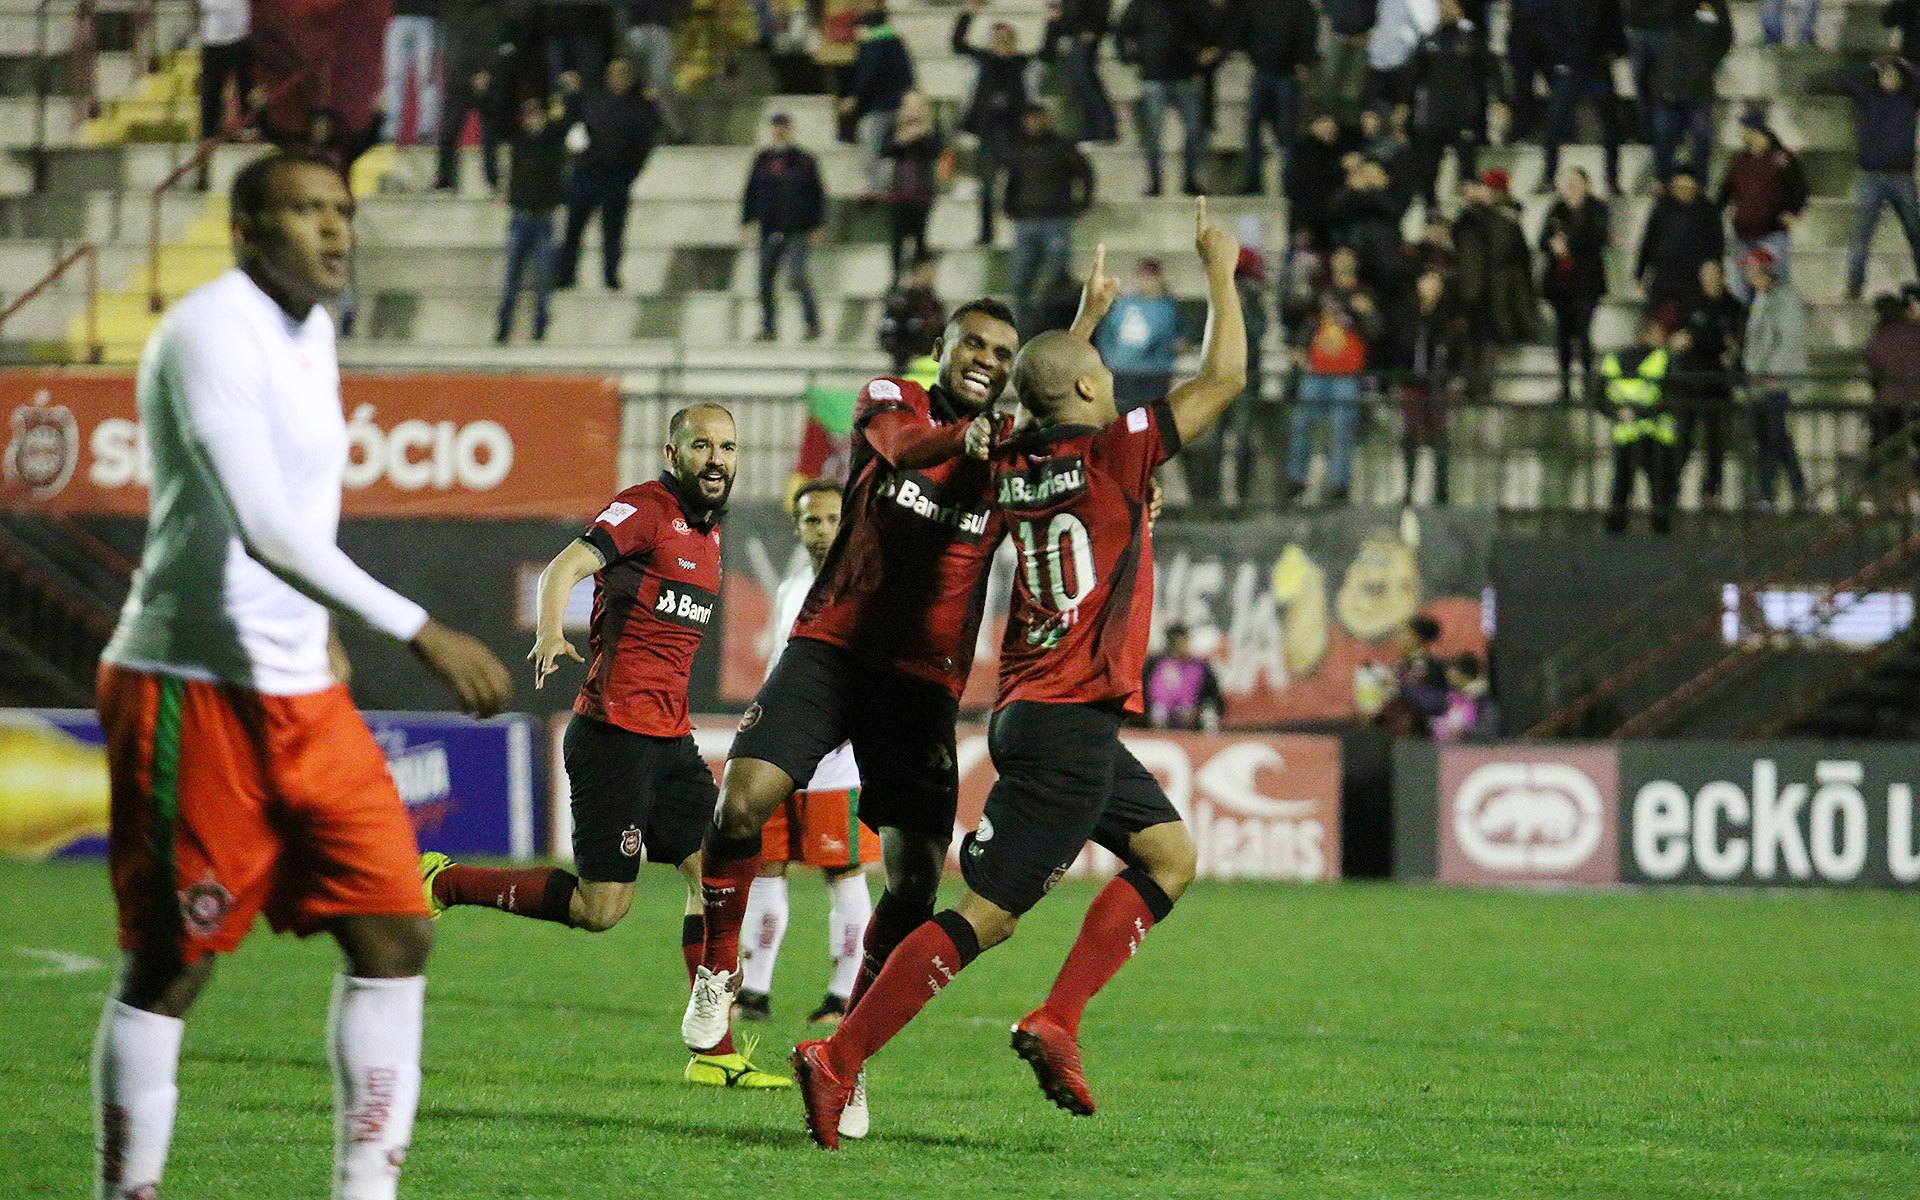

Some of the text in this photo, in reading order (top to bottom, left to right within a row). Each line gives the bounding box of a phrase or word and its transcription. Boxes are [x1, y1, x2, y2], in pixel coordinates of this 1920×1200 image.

[895, 479, 991, 535] Banrisul
[677, 557, 697, 571] Topper
[1019, 513, 1098, 612] 10
[677, 594, 714, 625] Banri
[1633, 758, 1868, 882] eckō
